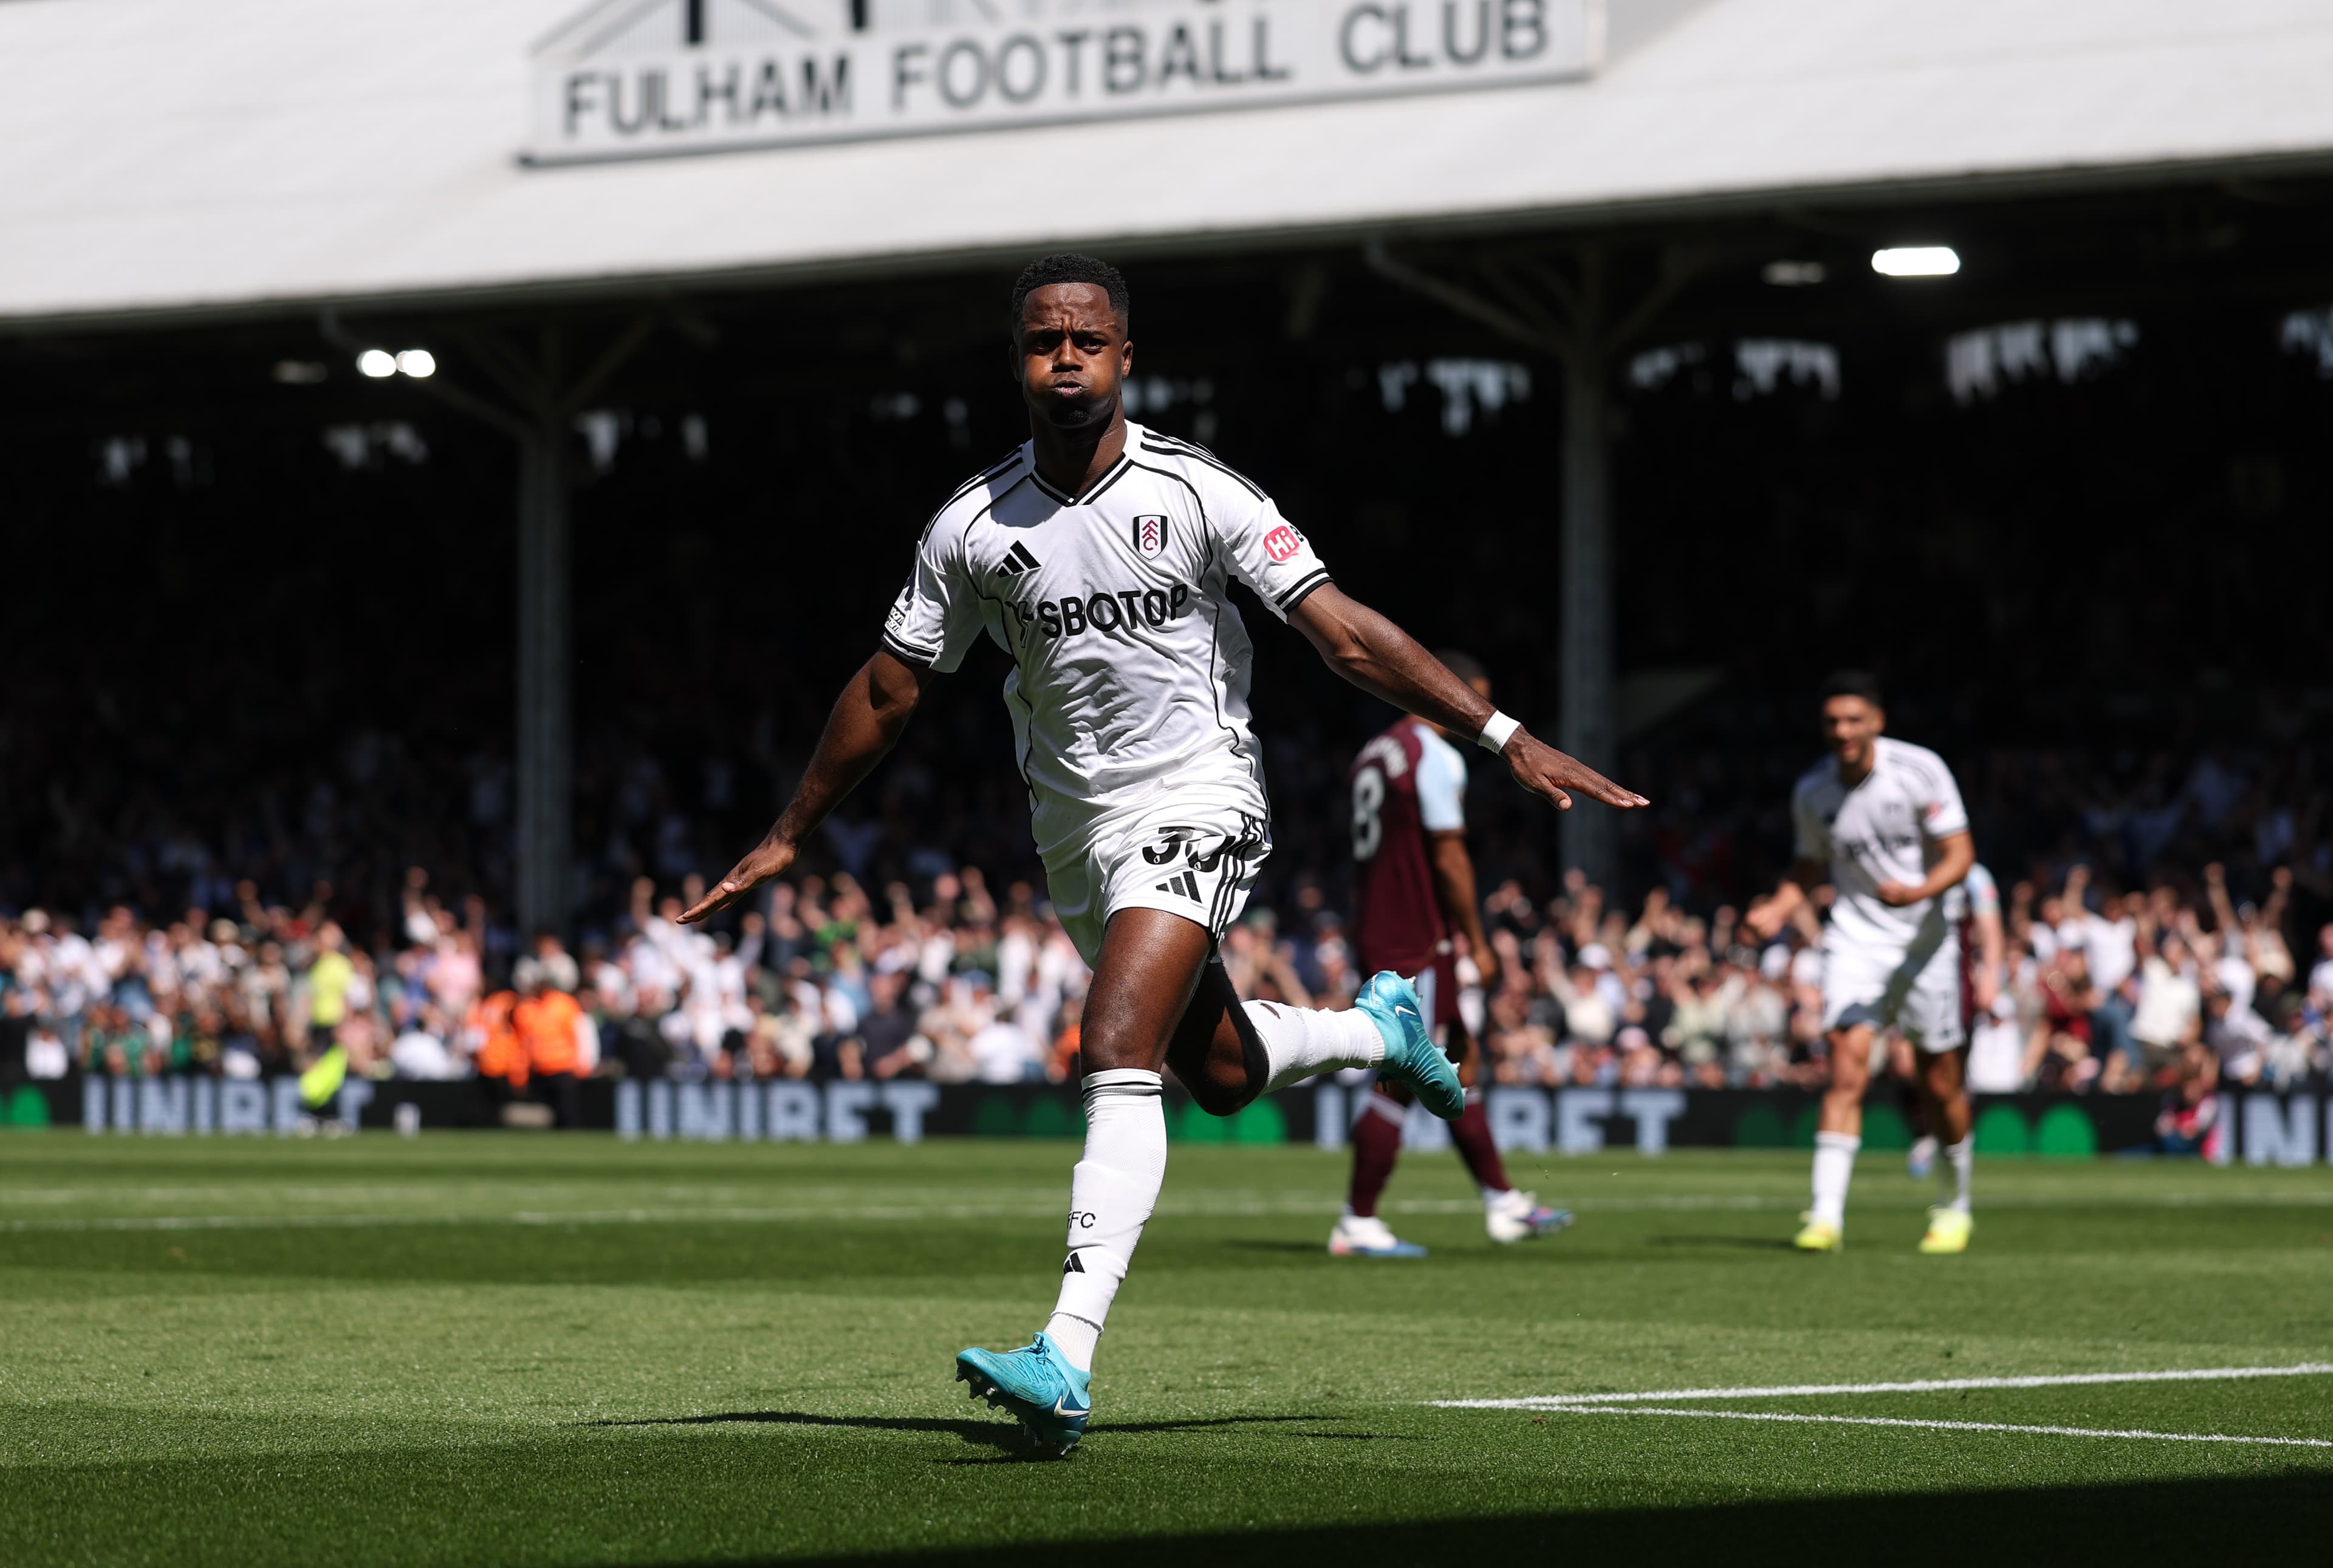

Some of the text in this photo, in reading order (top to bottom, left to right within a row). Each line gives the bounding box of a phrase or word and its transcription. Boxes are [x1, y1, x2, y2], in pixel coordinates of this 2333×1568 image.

[564, 0, 1548, 136] FULHAM FOOTBALL CLUB
[1267, 530, 1296, 560] Hi
[1036, 583, 1188, 638] SBOTOP
[614, 1079, 939, 1143] UNIBET
